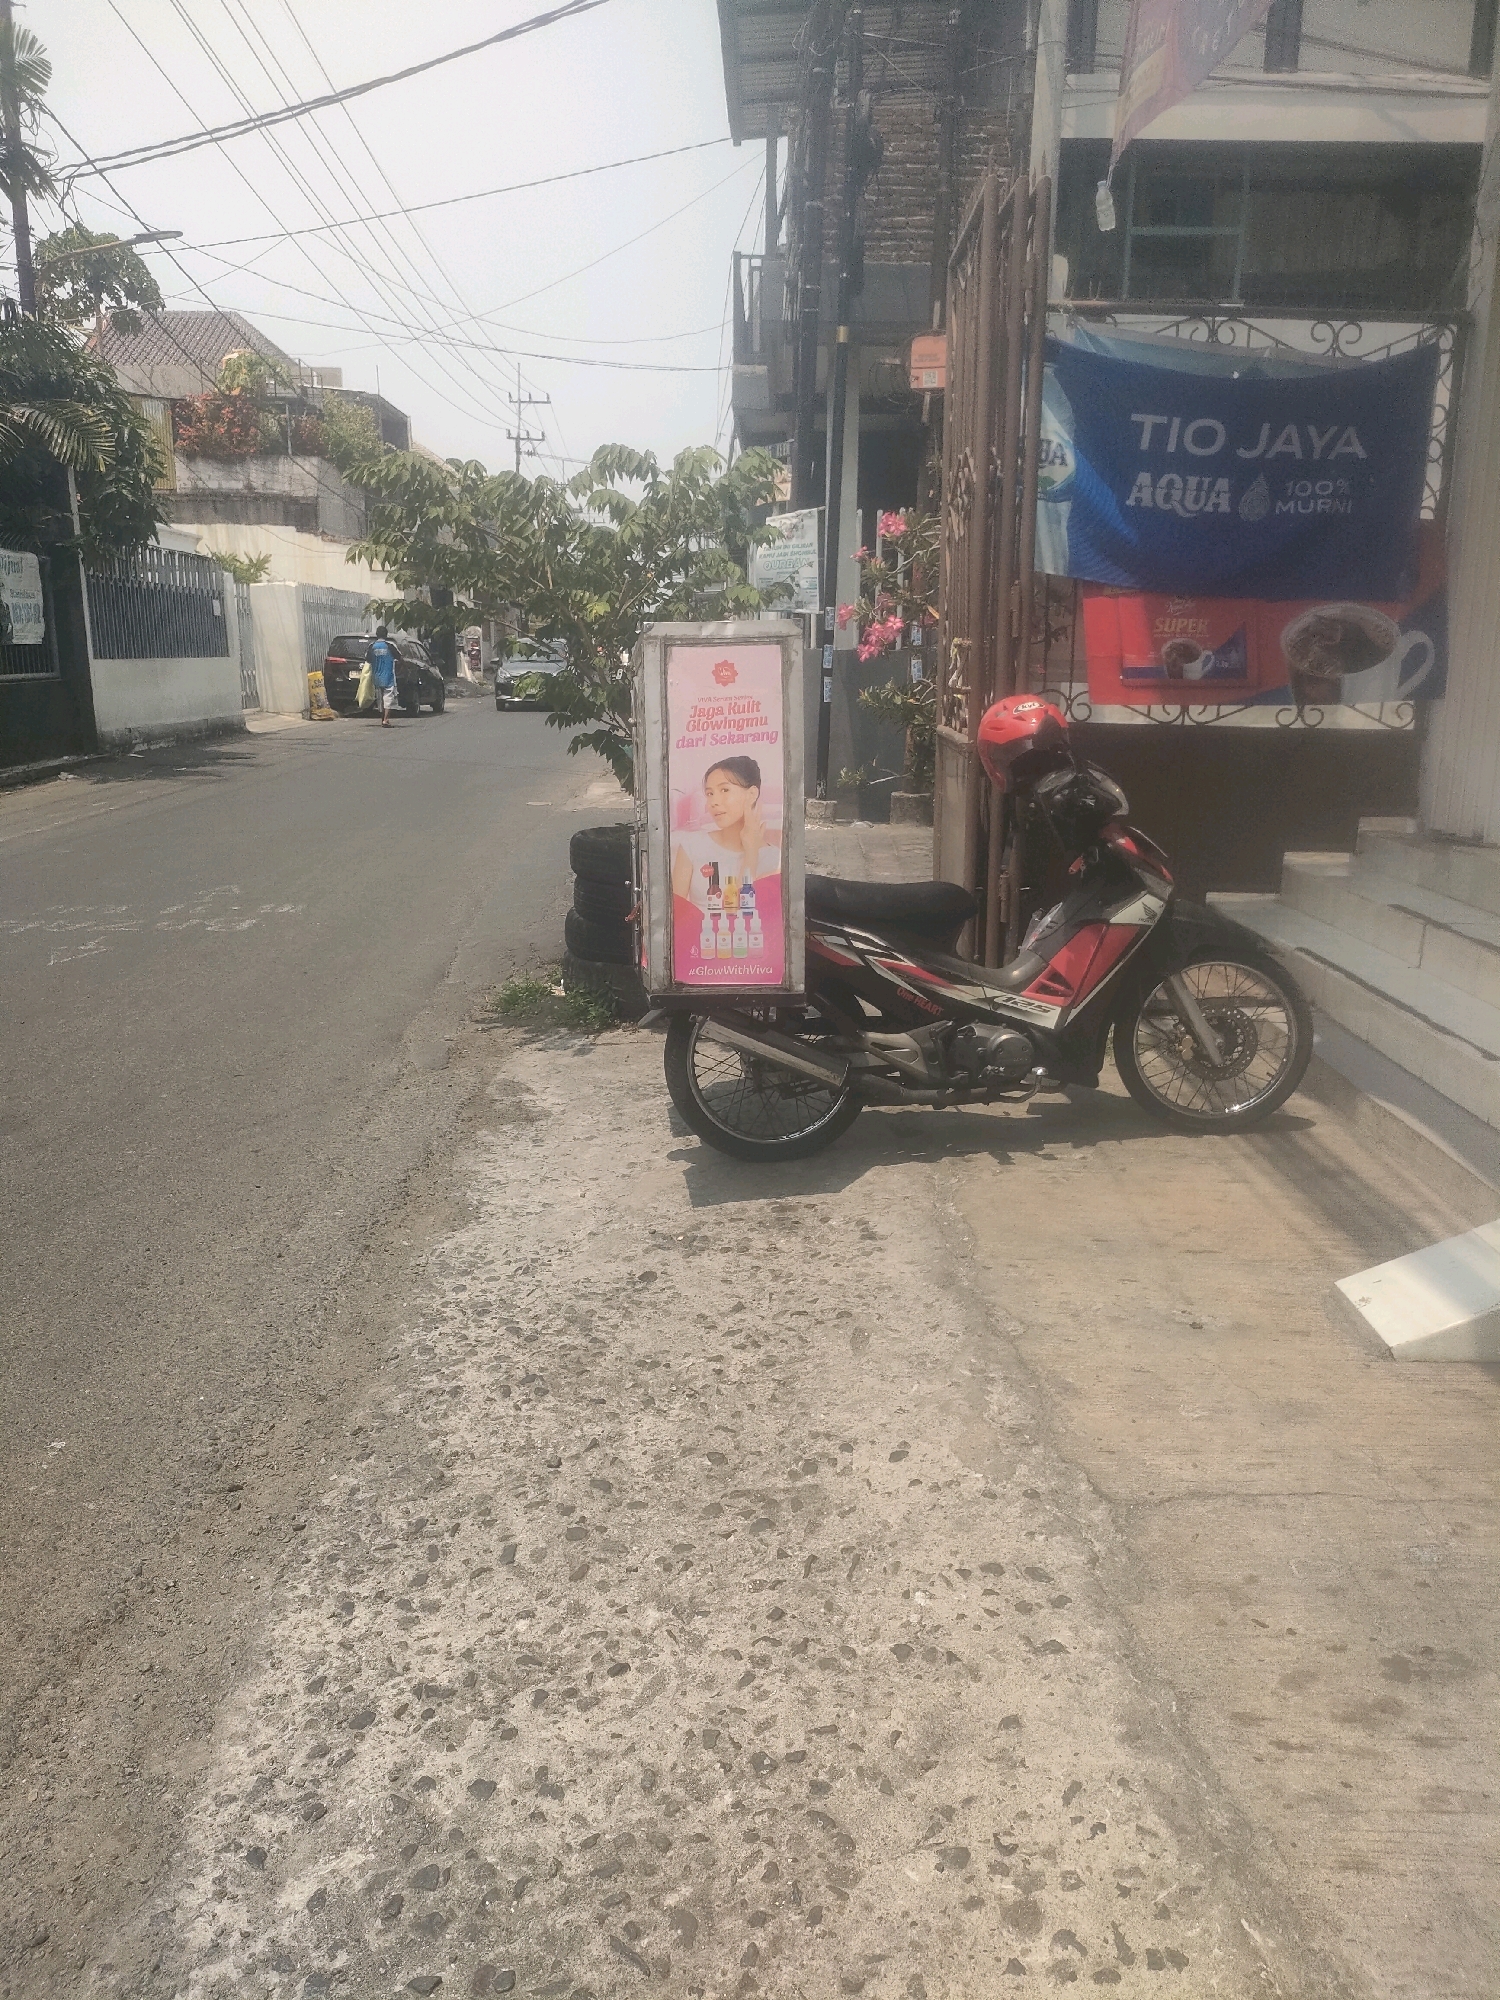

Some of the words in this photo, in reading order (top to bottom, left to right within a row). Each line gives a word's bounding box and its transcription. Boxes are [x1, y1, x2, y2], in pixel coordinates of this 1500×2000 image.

[1130, 413, 1227, 456] TIO
[1236, 422, 1368, 460] JAYA
[1125, 471, 1231, 518] AQUA
[1285, 477, 1350, 498] 100%
[1274, 498, 1352, 515] MURNI
[1153, 617, 1209, 634] SUPER
[689, 704, 725, 720] Jaga
[727, 699, 762, 716] Kulit
[685, 715, 769, 733] Glowingmu
[675, 733, 708, 749] dari
[709, 730, 779, 745] Sekarang
[688, 964, 773, 976] #GlowWithViva
[896, 987, 914, 1003] One
[914, 995, 945, 1017] HEART
